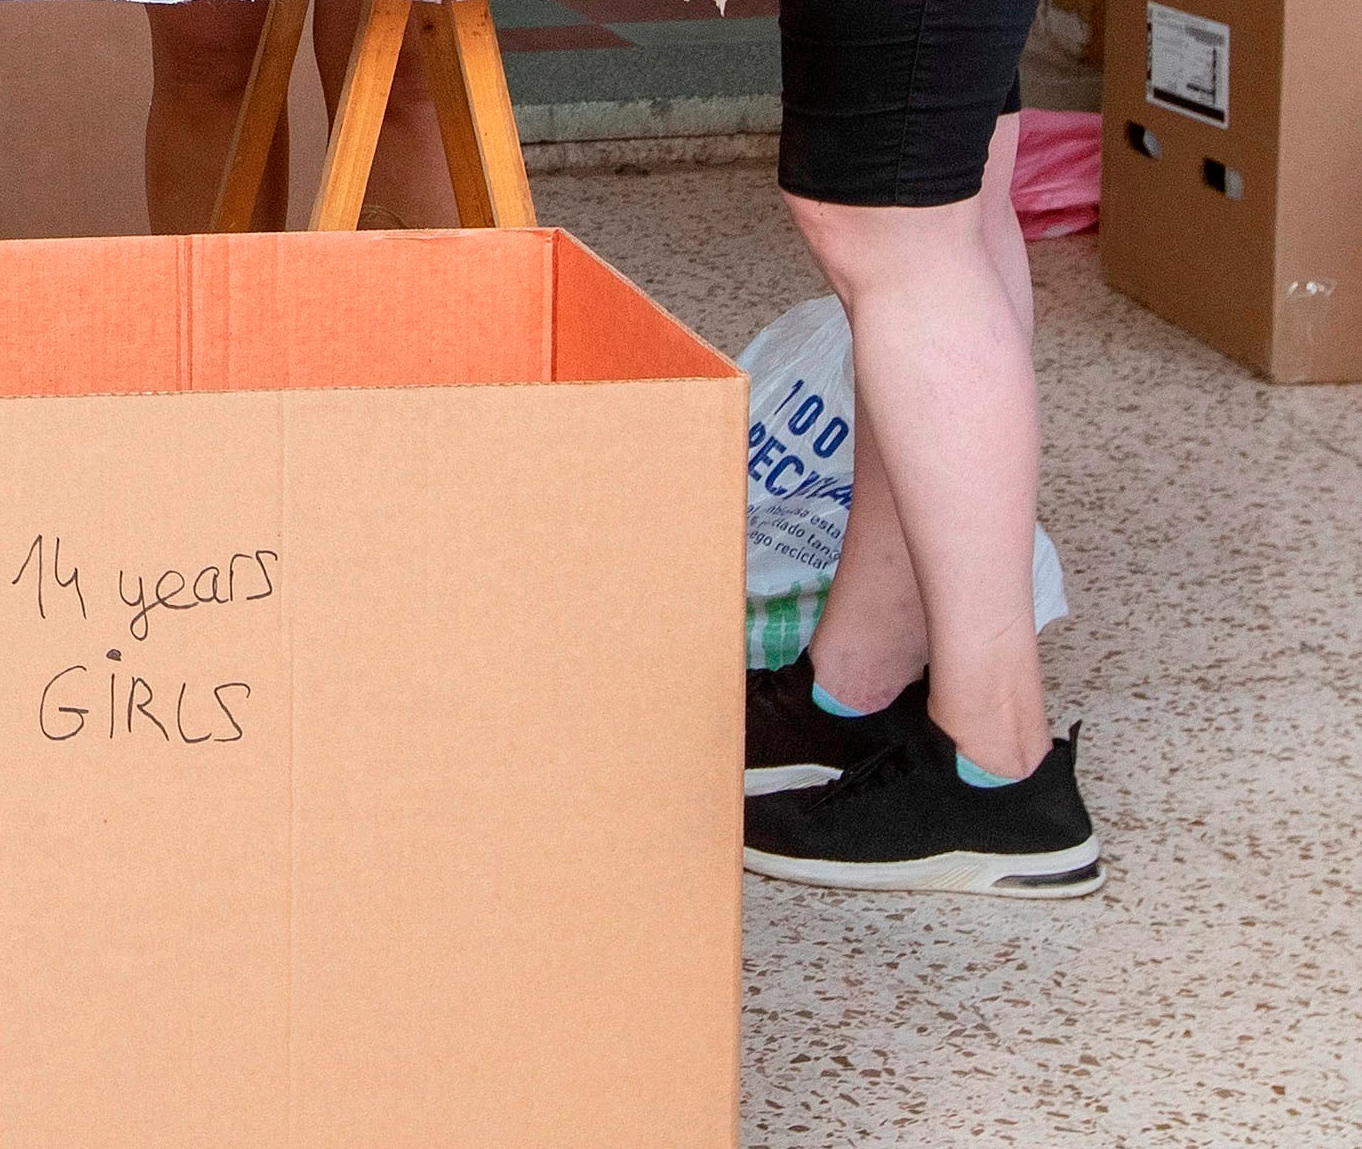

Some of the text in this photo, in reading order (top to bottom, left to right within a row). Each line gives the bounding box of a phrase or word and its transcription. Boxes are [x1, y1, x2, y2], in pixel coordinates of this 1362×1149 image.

[774, 378, 850, 459] 100
[809, 514, 842, 539] esta
[774, 541, 829, 570] reciclar
[11, 533, 279, 642] 14 years
